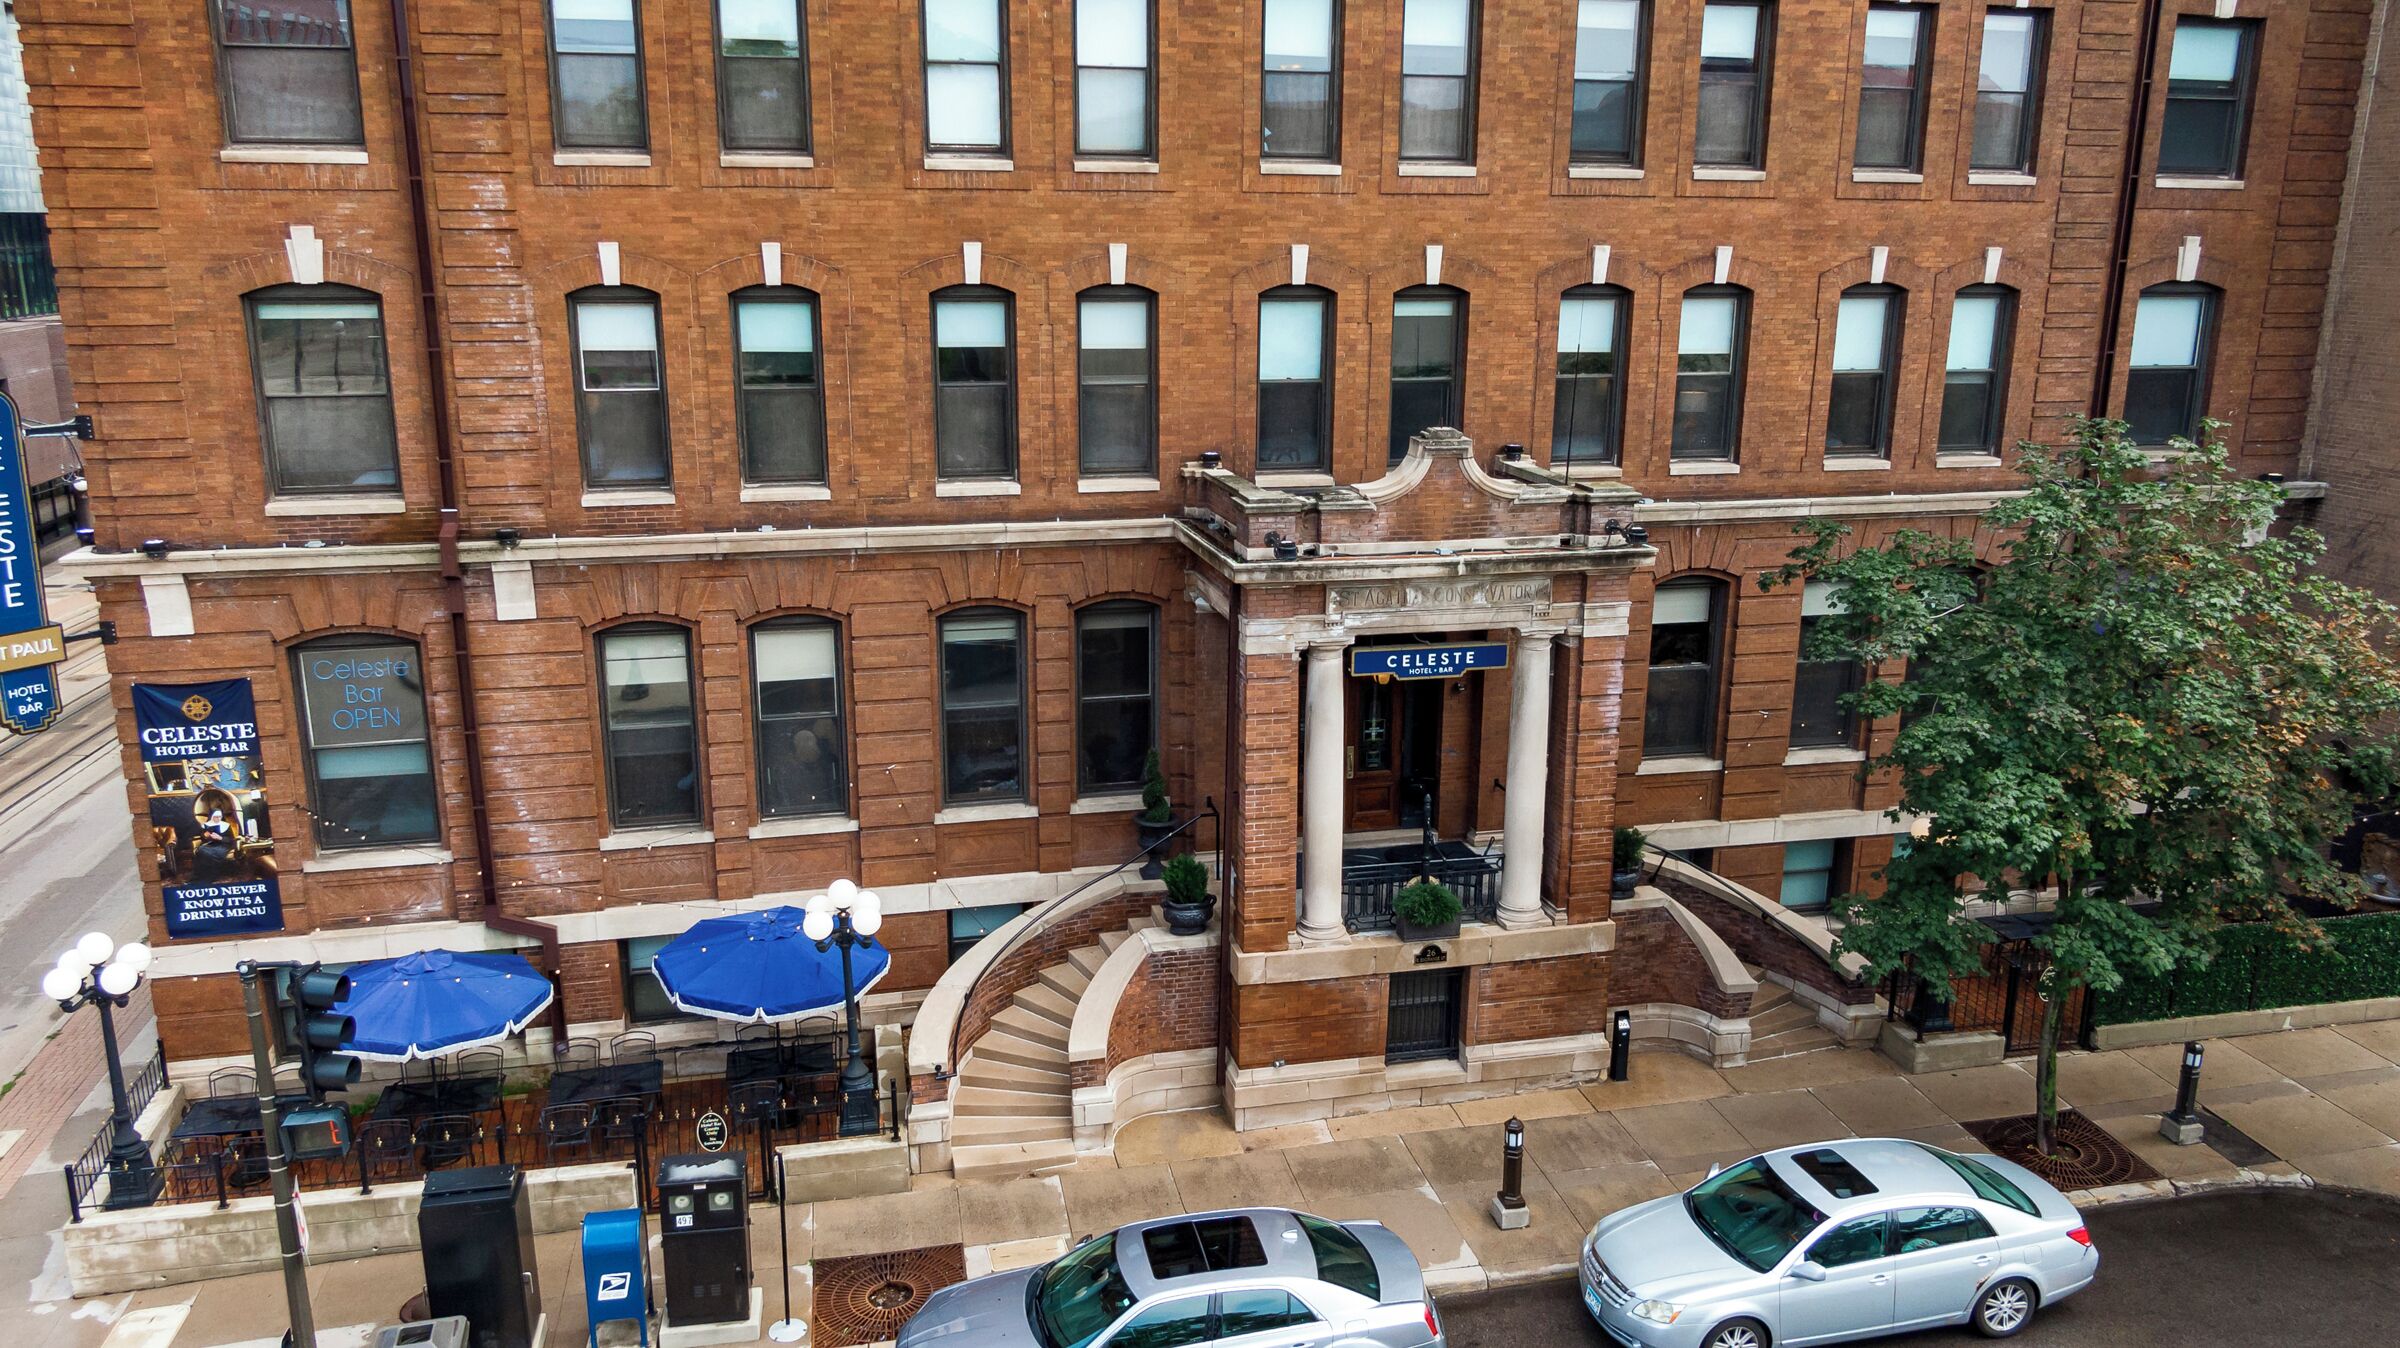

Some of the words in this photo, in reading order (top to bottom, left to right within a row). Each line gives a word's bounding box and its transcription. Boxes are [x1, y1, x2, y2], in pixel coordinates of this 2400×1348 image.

[1433, 583, 1541, 603] CONSVATORY
[10, 638, 59, 658] PAUL
[1386, 651, 1475, 668] CELESTE
[313, 656, 409, 680] Celeste
[1409, 667, 1432, 675] HOTEL
[8, 683, 48, 699] HOTEL
[345, 684, 384, 704] Bar
[18, 702, 43, 715] BAR
[332, 706, 401, 730] OPEN
[142, 723, 256, 744] CELESTE
[155, 744, 208, 756] HOTEL
[219, 742, 249, 753] BAR
[176, 887, 219, 899] YOU'D
[220, 884, 267, 896] NEVER
[184, 898, 225, 909] KNOW
[227, 896, 252, 906] IT'S
[253, 895, 264, 904] A
[180, 909, 225, 921] DRINK
[225, 906, 266, 917] MENU
[1426, 949, 1436, 957] 26
[677, 1216, 692, 1225] 497
